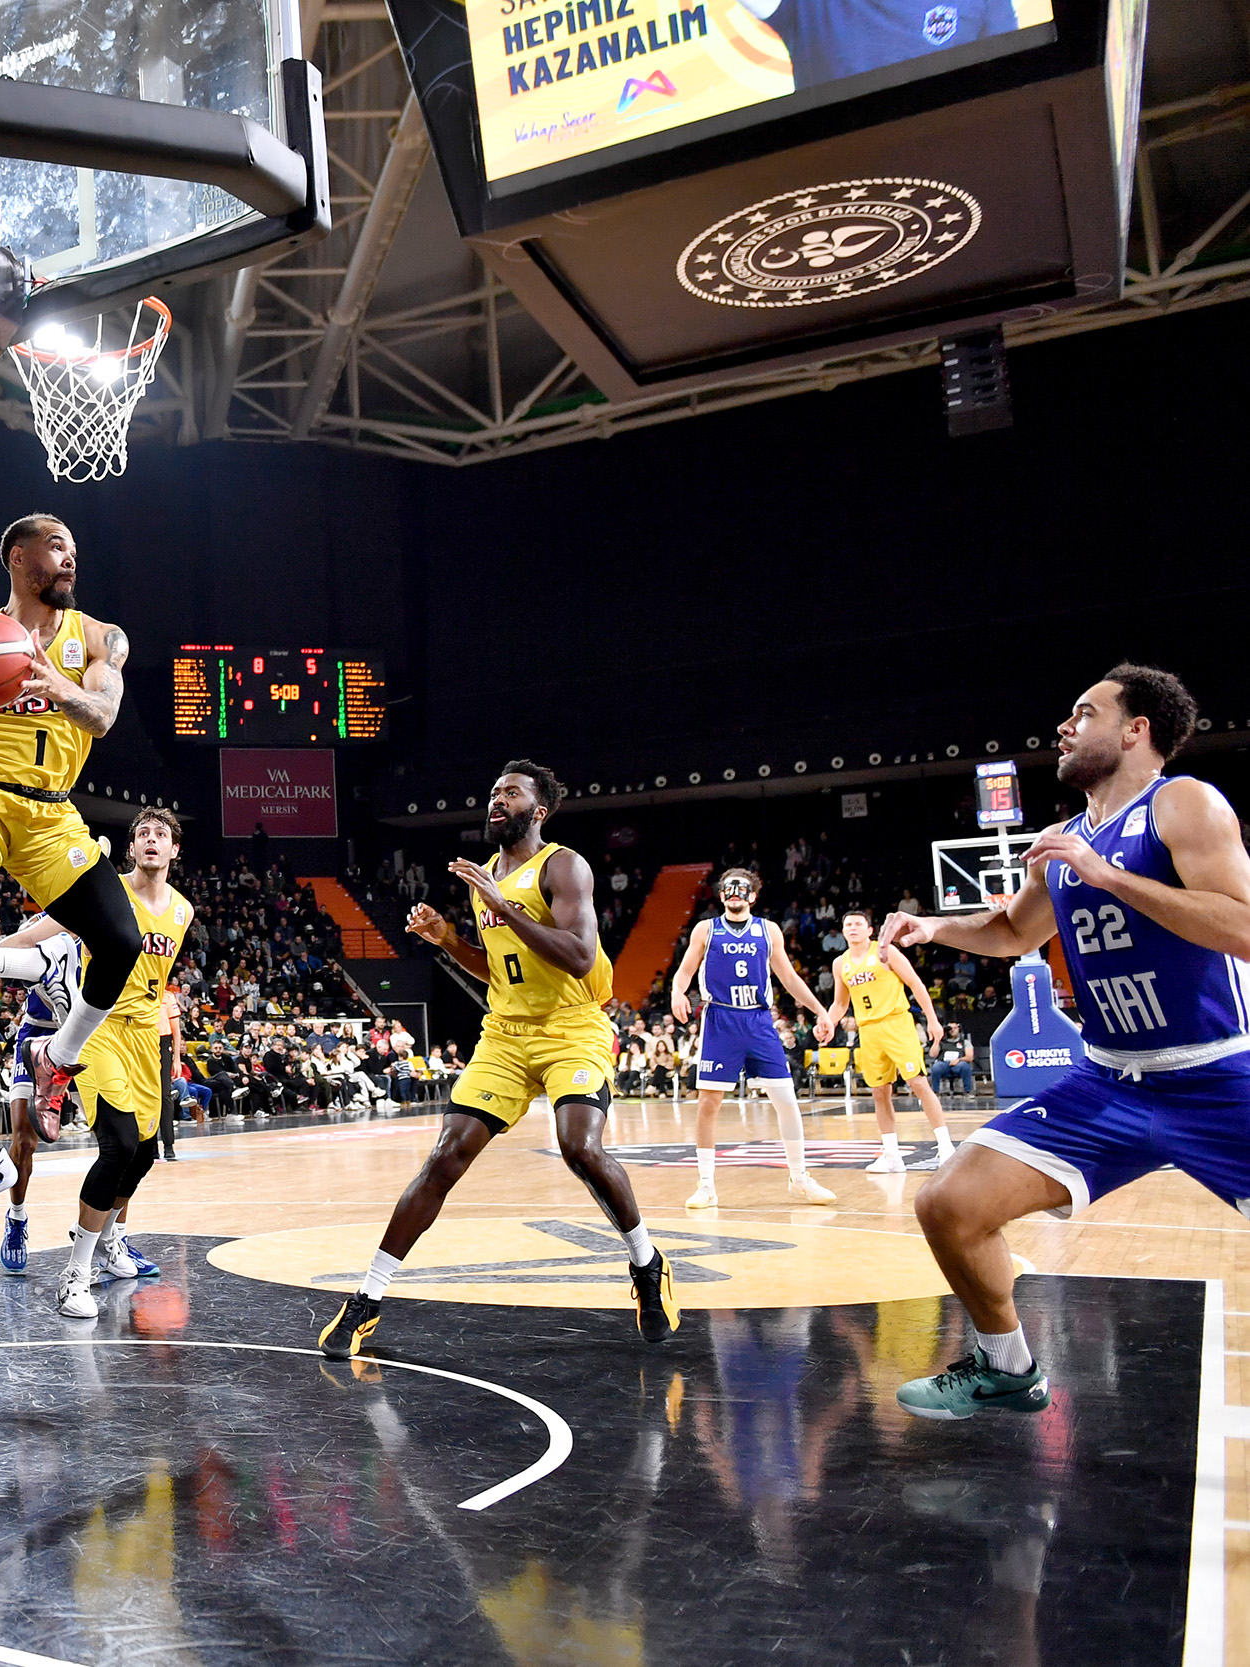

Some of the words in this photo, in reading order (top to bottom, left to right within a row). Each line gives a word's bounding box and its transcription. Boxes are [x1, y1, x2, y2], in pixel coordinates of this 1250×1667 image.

[507, 4, 707, 97] KAZANALIM
[763, 212, 814, 234] SPOR
[818, 205, 915, 222] BAKANLIĞI
[306, 657, 317, 675] 5
[270, 684, 299, 700] 5:08
[34, 729, 48, 766] 1
[226, 785, 331, 799] MEDICALPARK
[985, 775, 1012, 790] 5:08
[990, 789, 1012, 811] 15
[1071, 904, 1133, 954] 22
[722, 942, 758, 957] TOFAŞ
[503, 953, 525, 985] 0
[735, 960, 748, 978] 6
[847, 971, 876, 987] MSK
[144, 978, 159, 1001] 5
[730, 985, 759, 1007] FIAT
[862, 995, 872, 1010] 9
[1086, 970, 1168, 1034] FIAT
